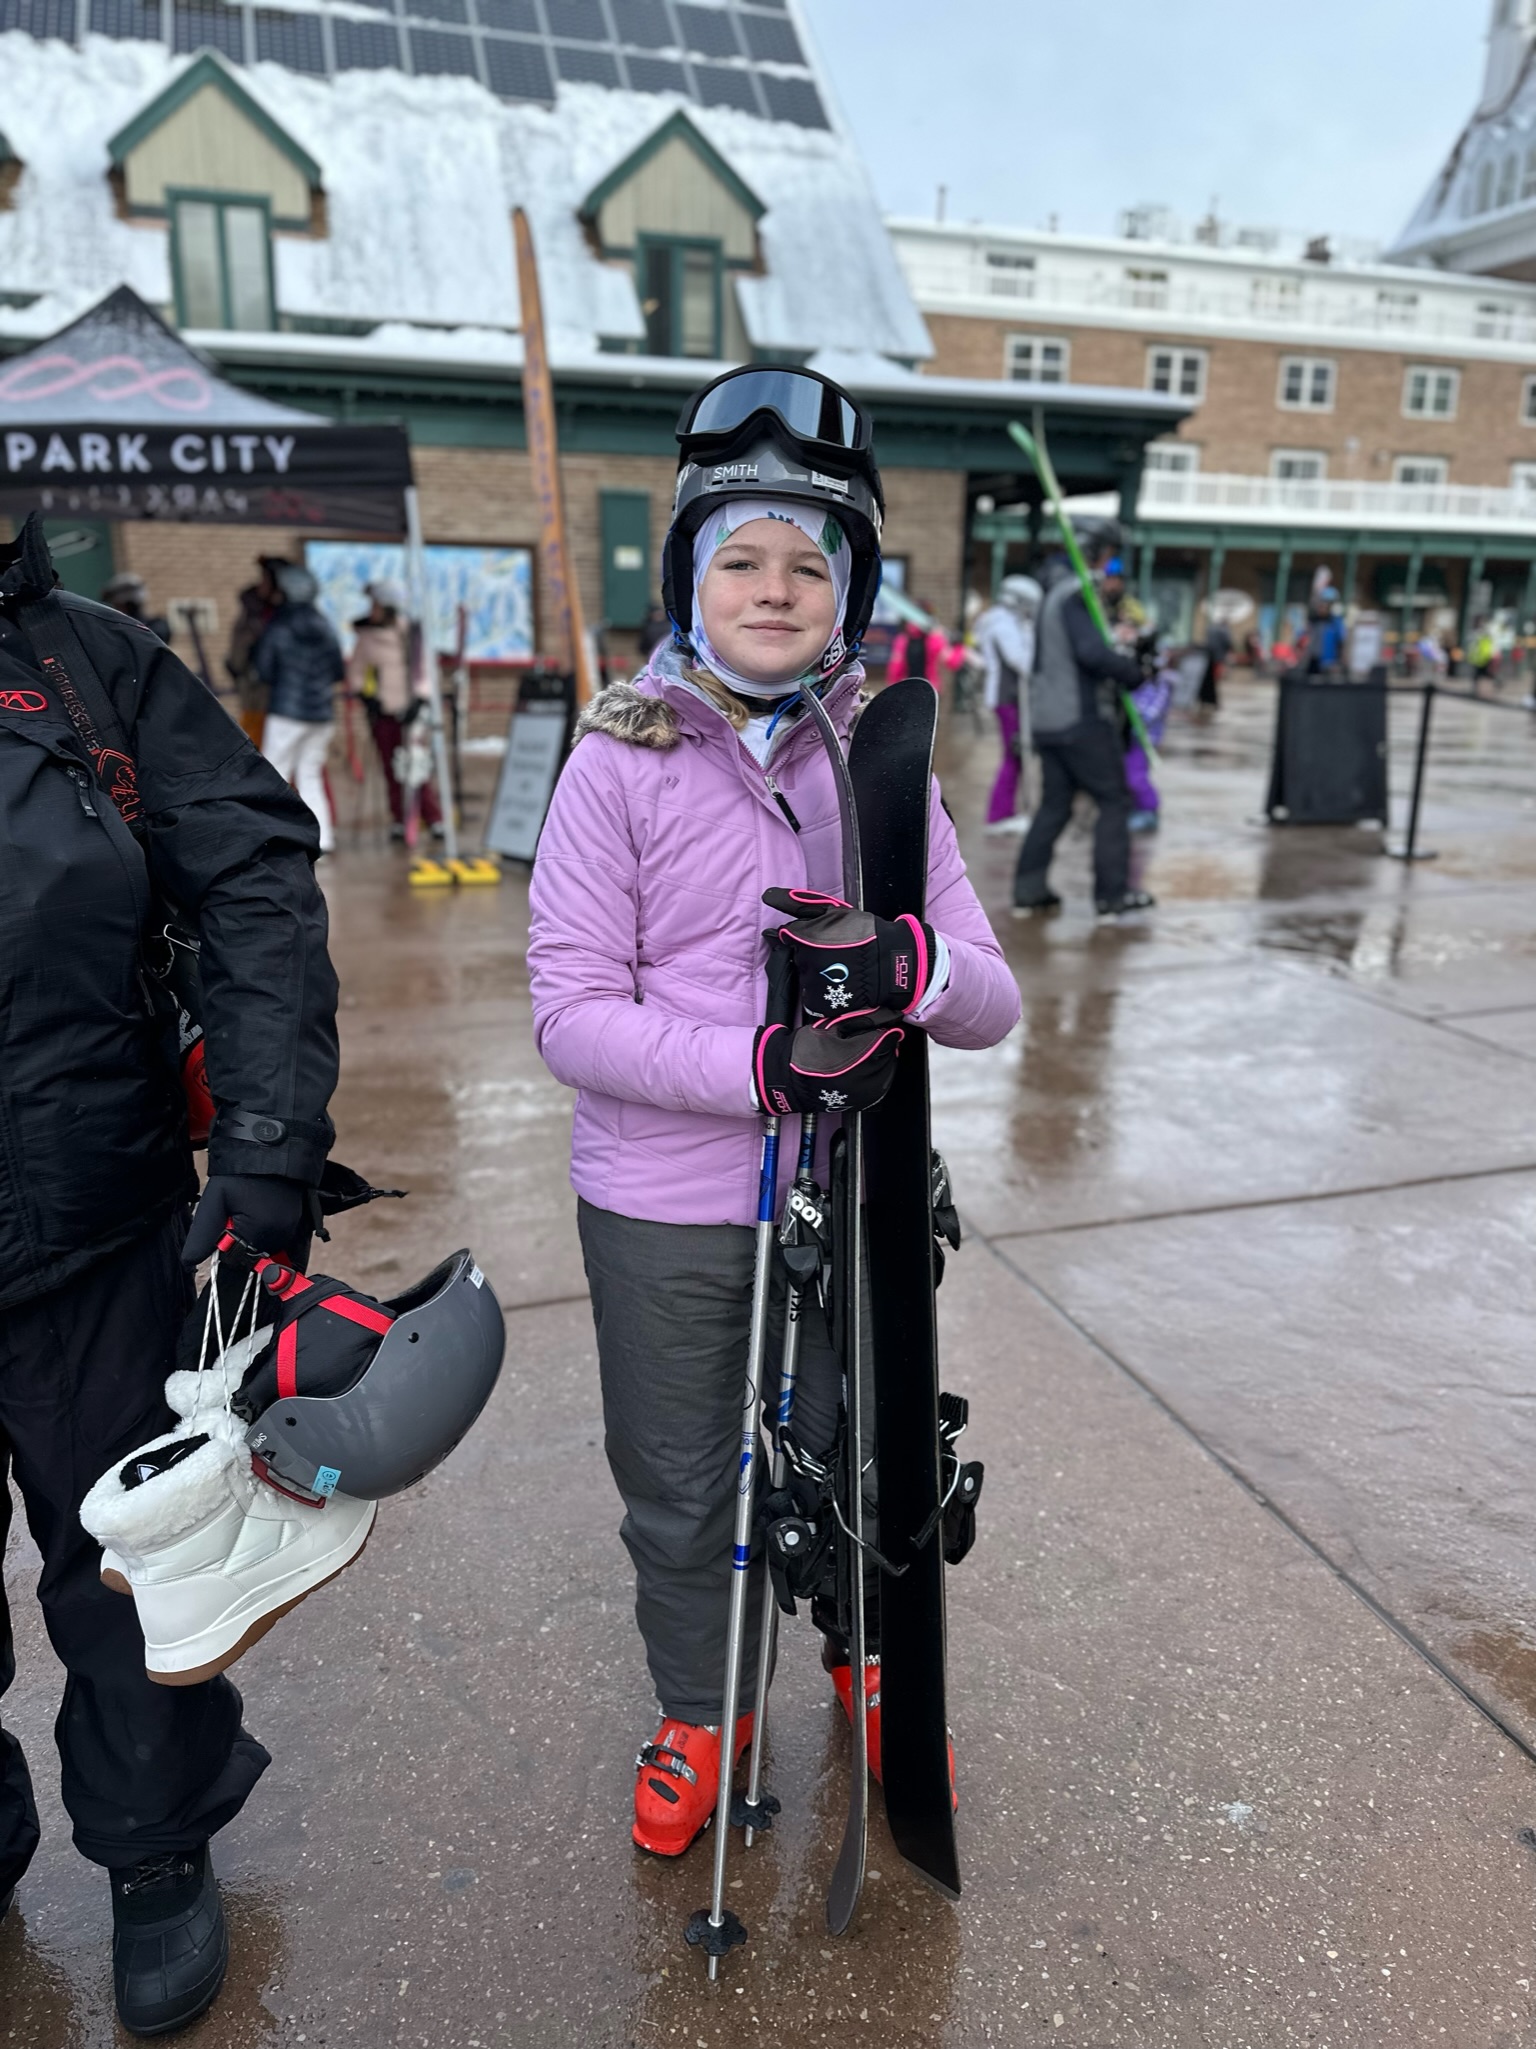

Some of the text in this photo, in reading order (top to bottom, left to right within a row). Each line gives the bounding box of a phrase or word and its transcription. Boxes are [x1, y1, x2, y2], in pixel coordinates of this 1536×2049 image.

[5, 432, 296, 474] PARK CITY
[714, 464, 758, 479] SMITH
[790, 1193, 824, 1229] LOO
[251, 1432, 267, 1449] SMITH
